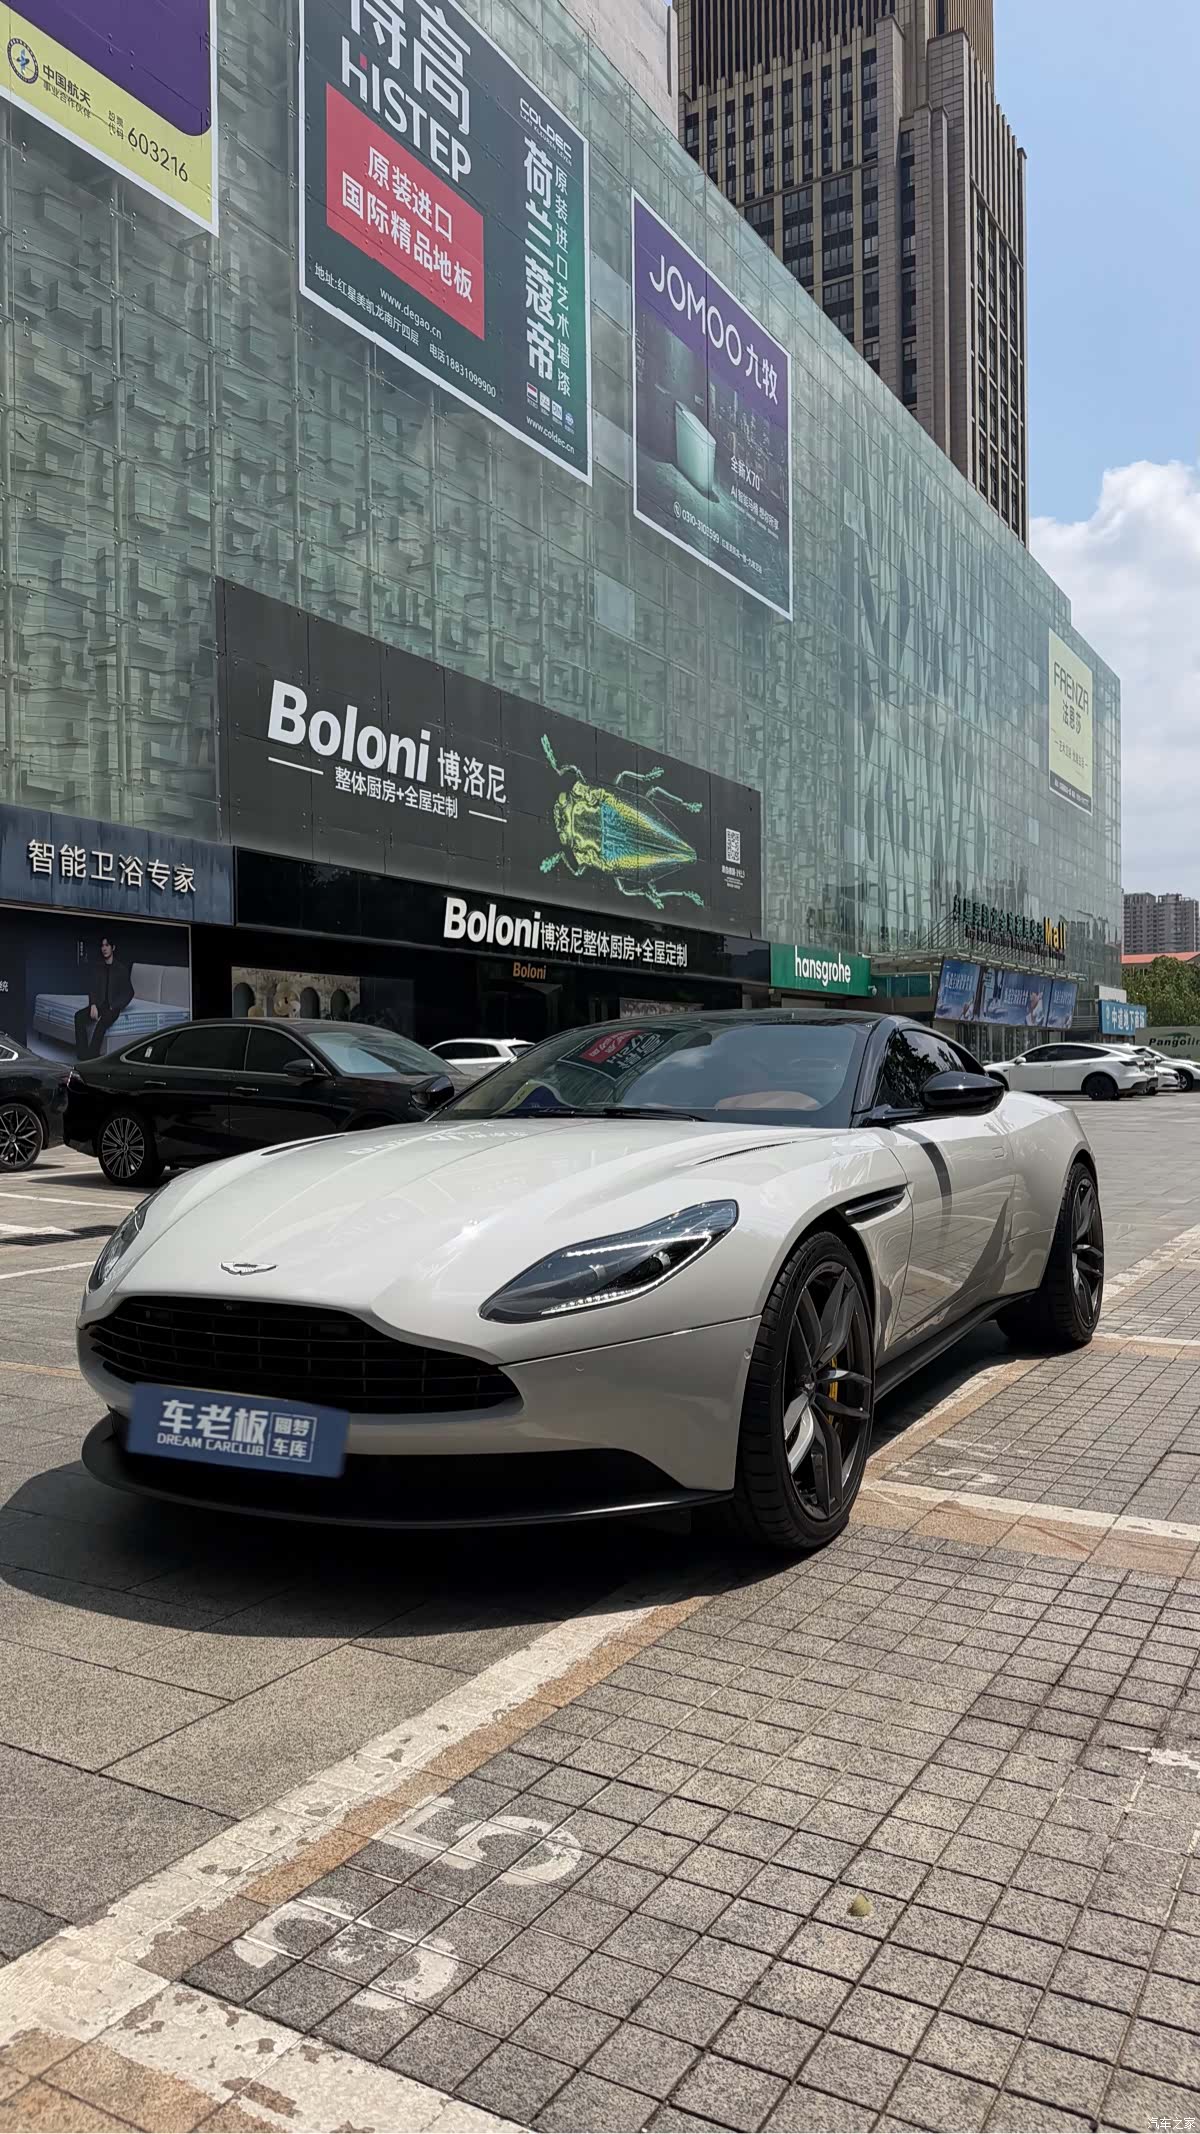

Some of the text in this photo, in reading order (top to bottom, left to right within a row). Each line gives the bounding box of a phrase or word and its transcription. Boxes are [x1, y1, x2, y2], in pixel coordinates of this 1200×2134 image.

[42, 64, 91, 108] 中国航天
[43, 80, 92, 119] 事业合作伙伴
[108, 122, 124, 139] 代码
[127, 127, 188, 182] 603216
[520, 97, 572, 159] COLDEC
[368, 146, 452, 243] 原装进口
[342, 171, 472, 303] 国际精品地板
[524, 136, 554, 381] 荷兰蔻帝
[555, 164, 571, 397] 原装进口艺术墙漆
[380, 288, 442, 340] www.degao.cn
[649, 254, 778, 404] JOMOO 九牧
[526, 416, 575, 454] www.coldec.cn
[1054, 661, 1088, 715] FAENZA
[267, 679, 507, 804] Boloni 博洛尼
[335, 766, 458, 819] 整体厨房+全屋定制
[28, 839, 197, 893] 智能卫浴专家
[443, 896, 688, 968] Boloni 博洛尼整体厨房+全屋定制
[512, 962, 547, 980] Boloni
[794, 945, 851, 987] hansgrohe
